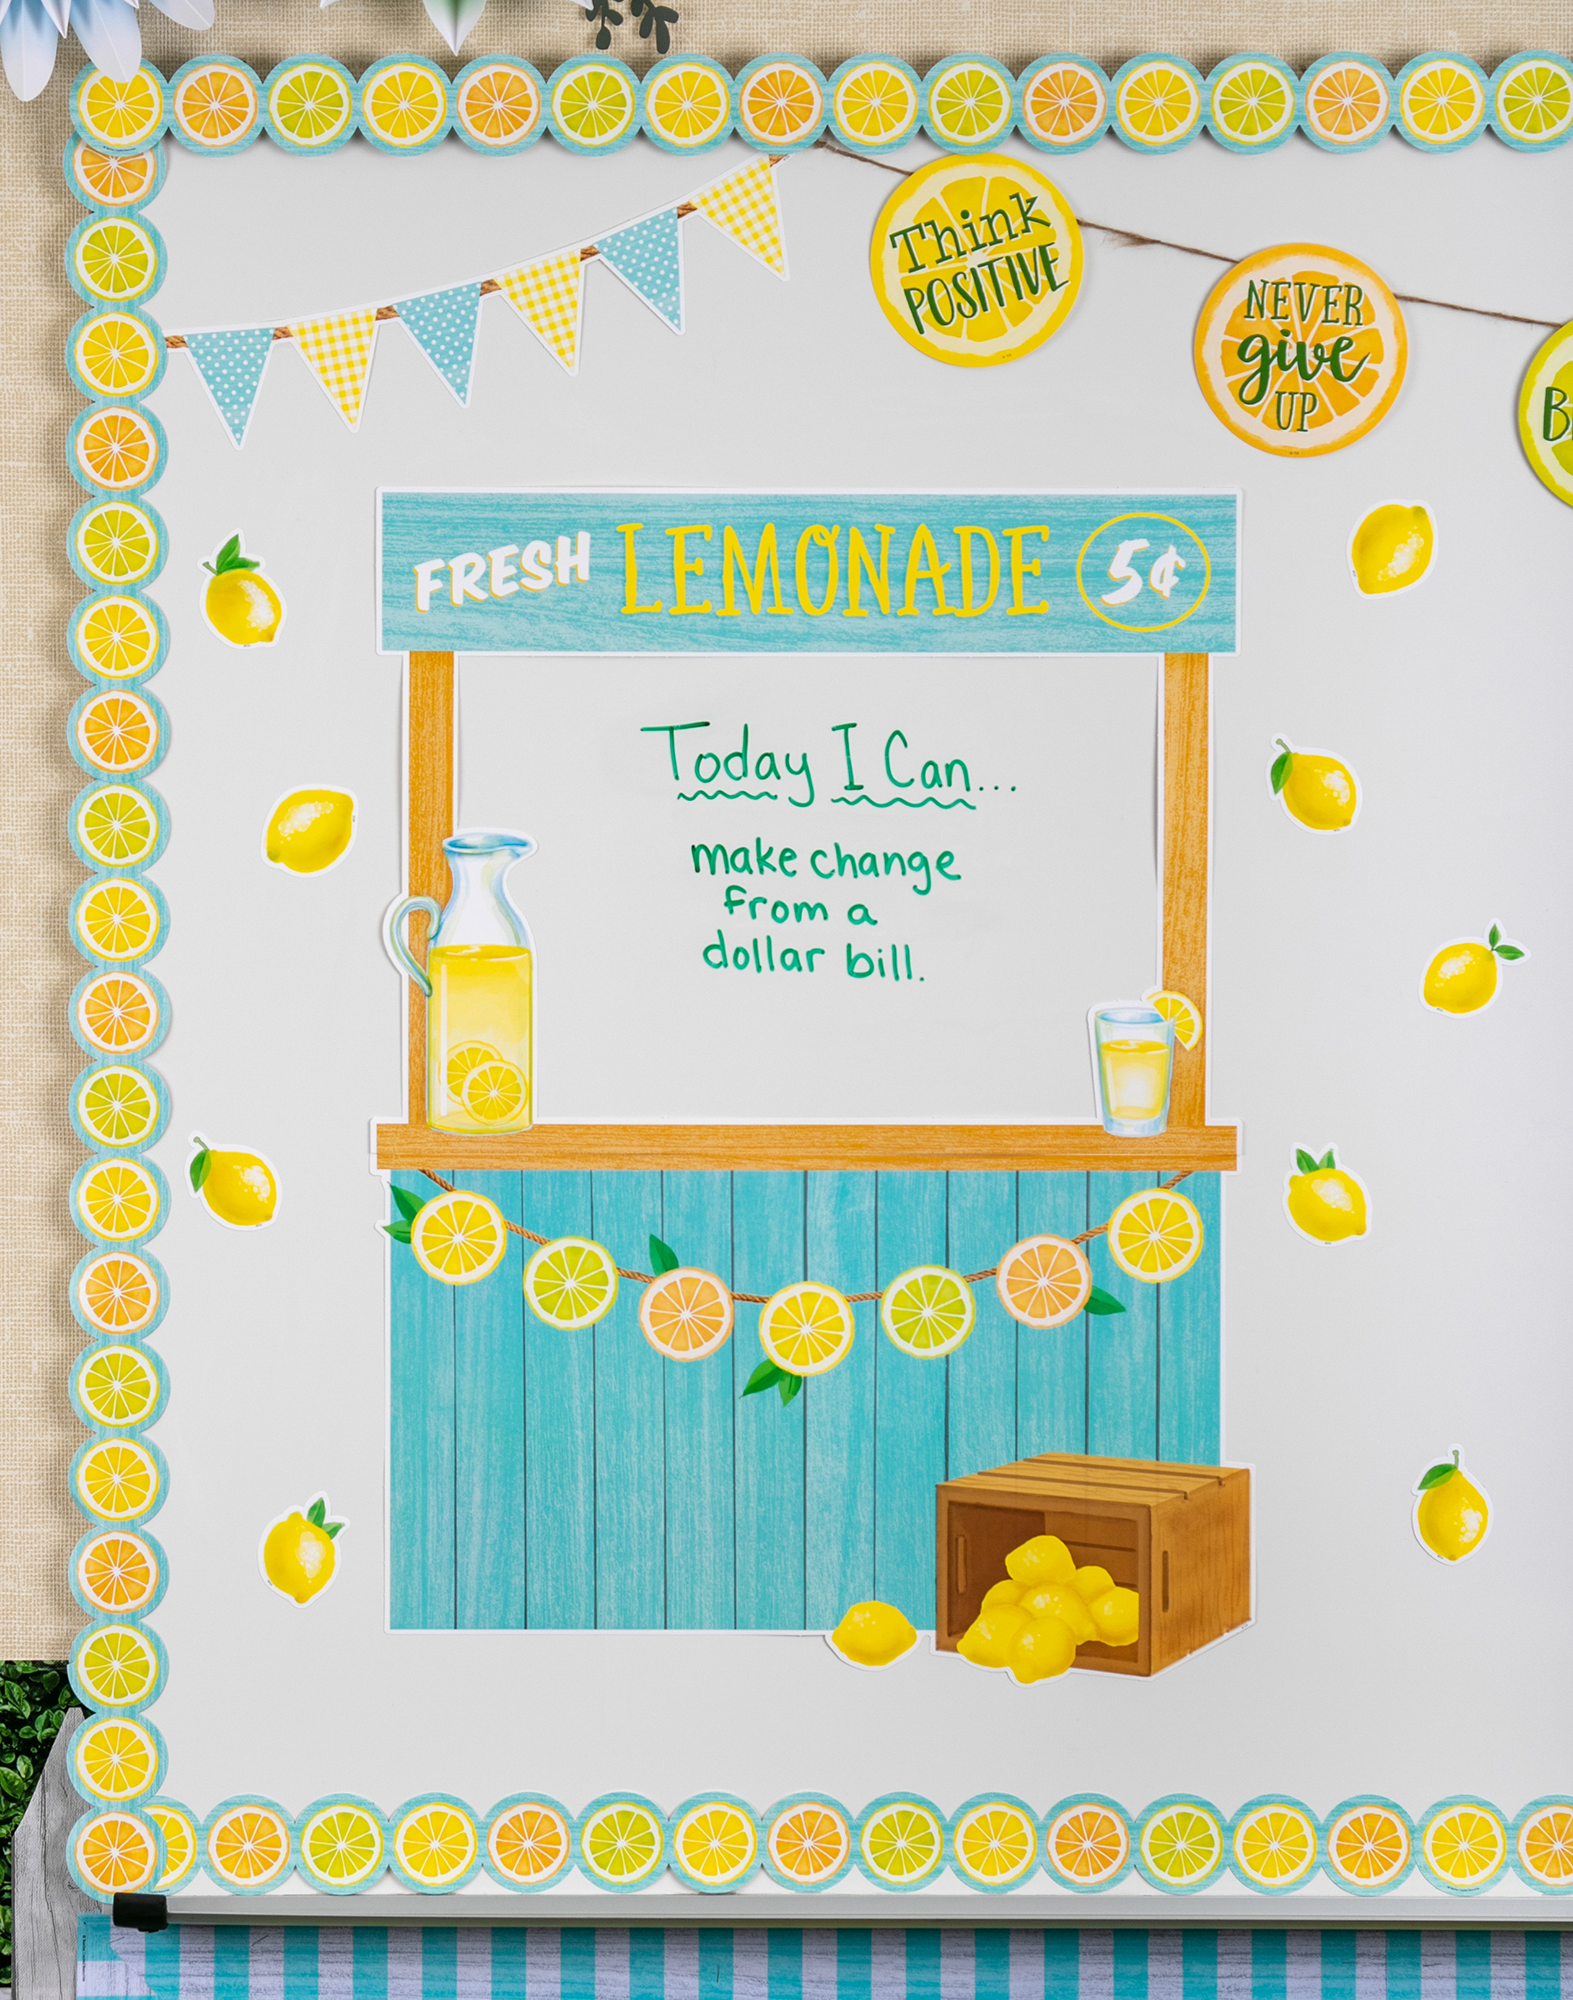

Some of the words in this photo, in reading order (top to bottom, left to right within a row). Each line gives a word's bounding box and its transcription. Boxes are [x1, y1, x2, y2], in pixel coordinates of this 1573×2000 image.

[889, 192, 1053, 274] Think
[903, 242, 1070, 335] POSITIVE
[1243, 278, 1364, 326] NEVER
[1237, 328, 1371, 406] give
[1275, 390, 1318, 433] UP
[414, 530, 592, 613] FRESH
[616, 522, 1050, 618] LEMONADE
[1100, 538, 1187, 606] 5¢
[640, 721, 816, 808] Today
[830, 722, 865, 791] I
[884, 729, 1017, 793] Can...
[690, 836, 798, 879] make
[809, 841, 963, 897] change
[723, 884, 830, 925] from
[846, 903, 879, 927] a
[701, 928, 827, 975] dollar
[845, 942, 926, 983] bill.
